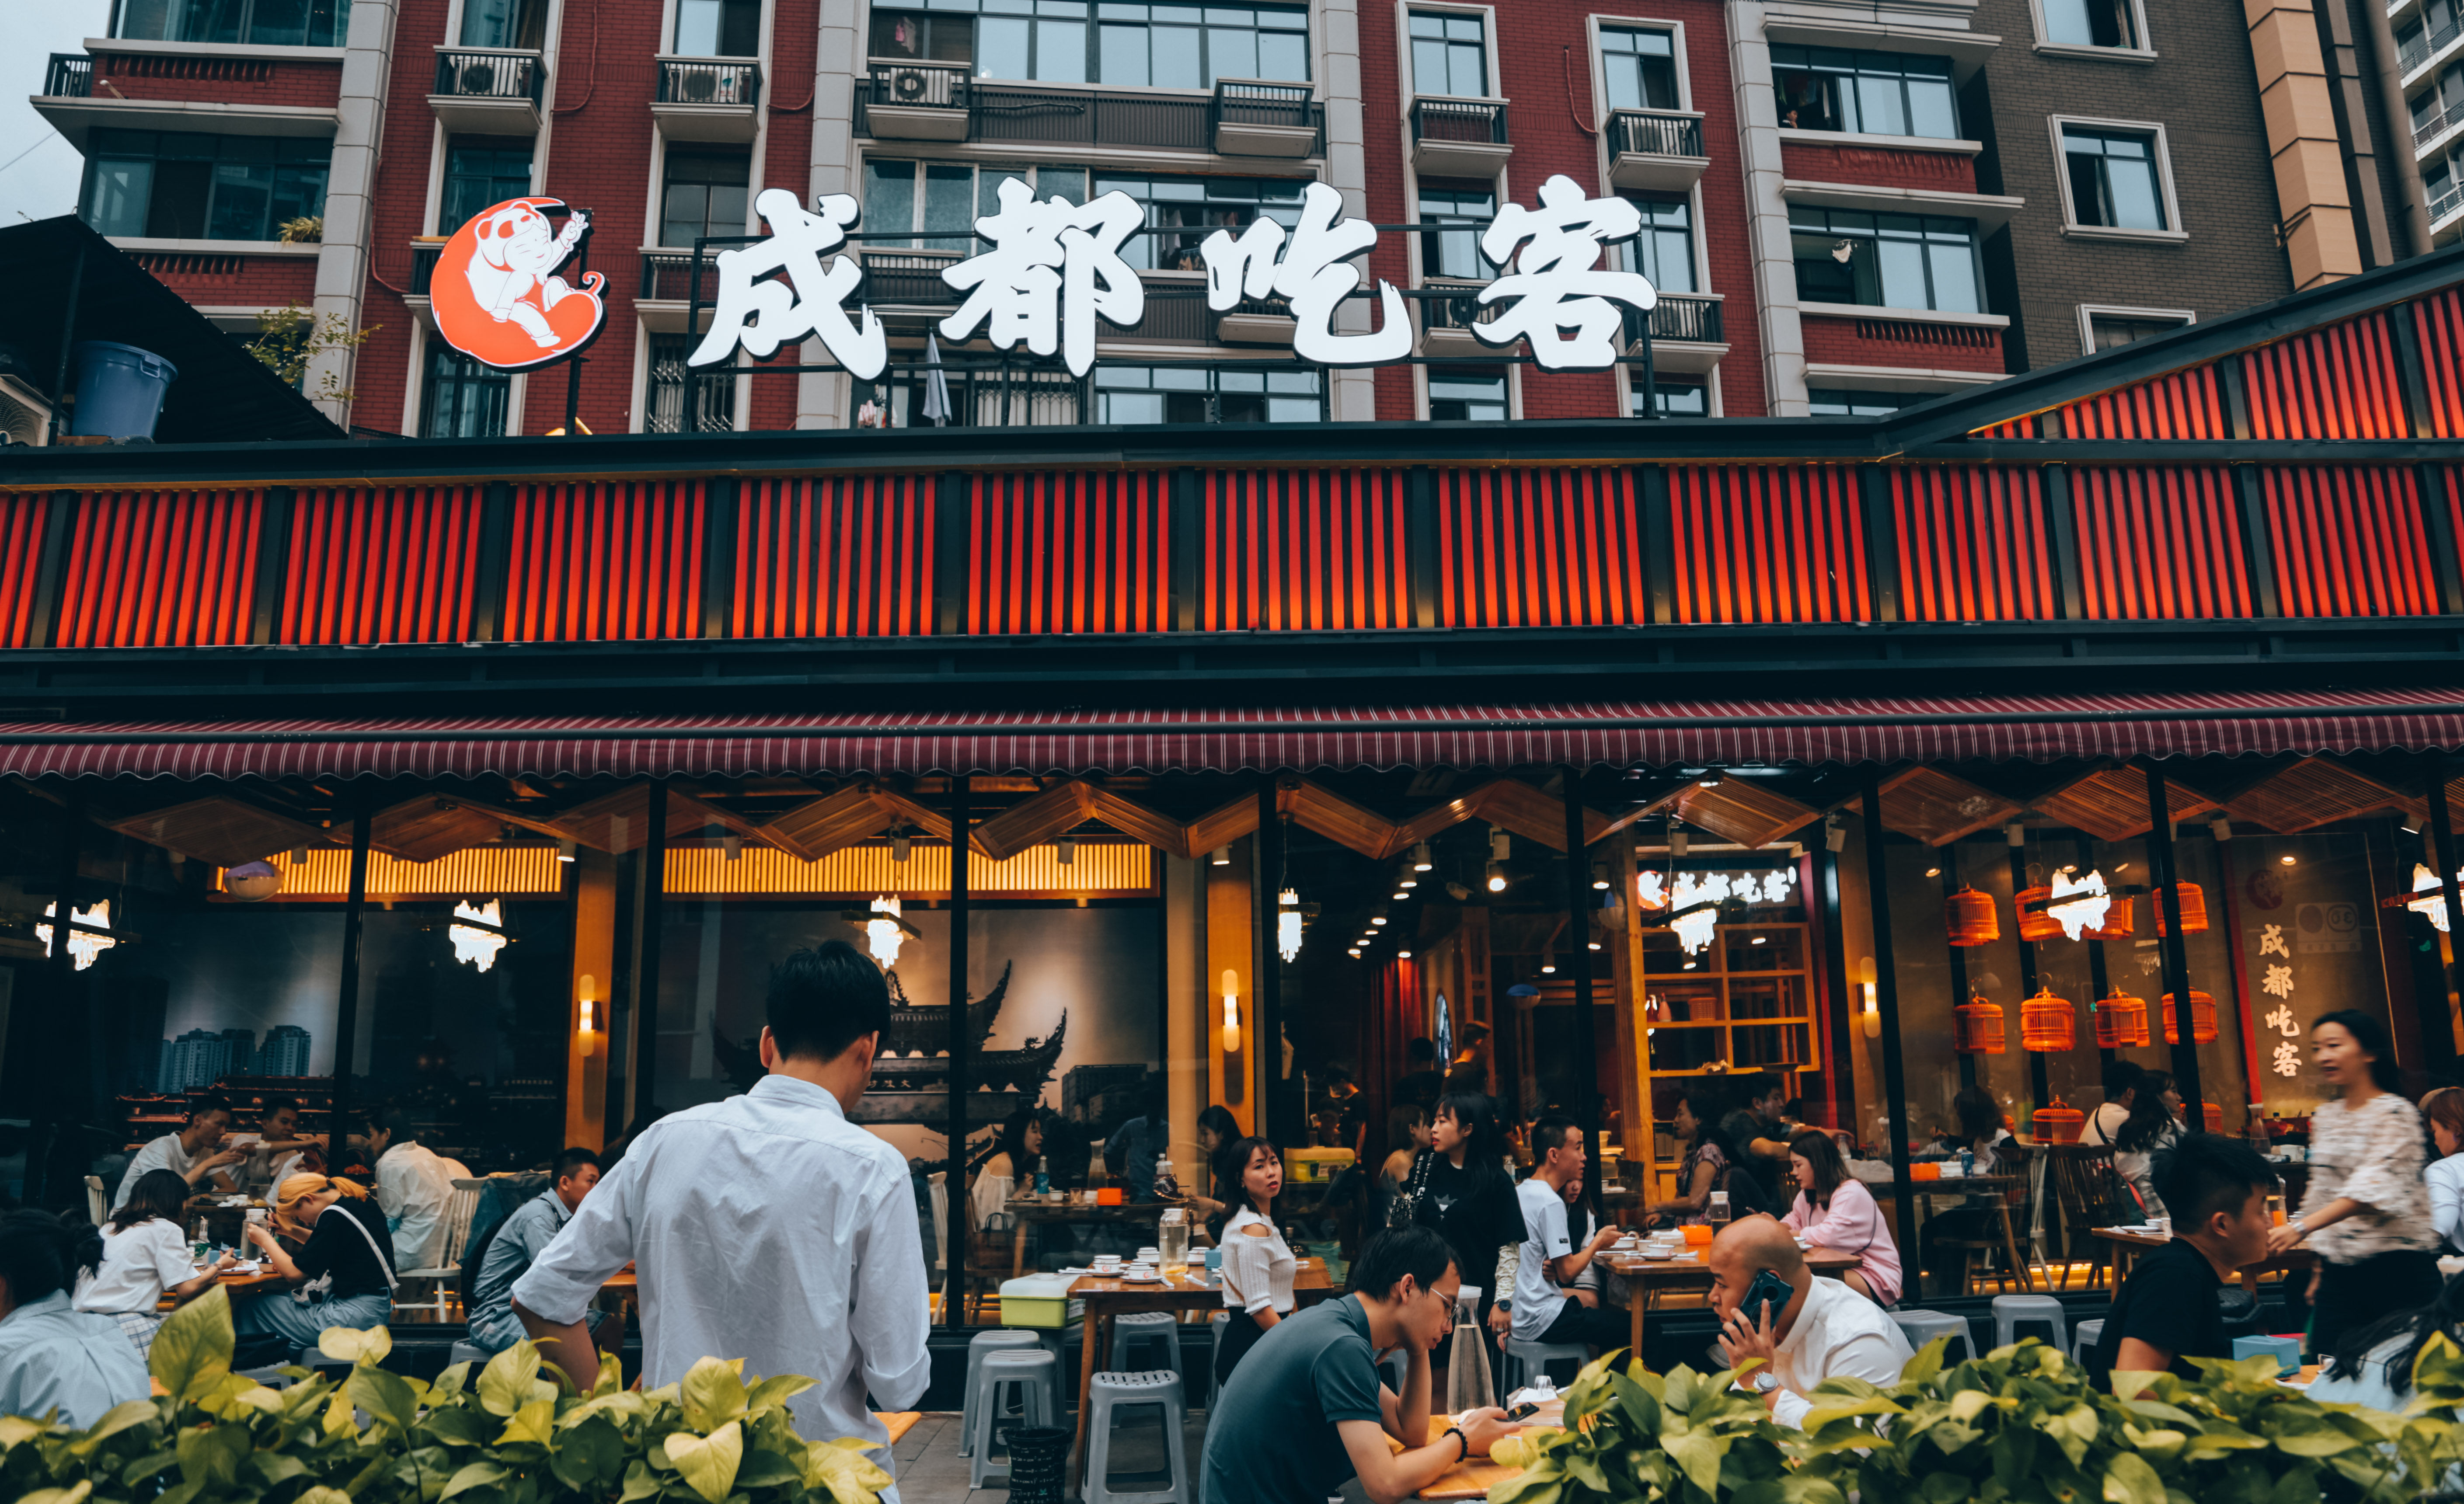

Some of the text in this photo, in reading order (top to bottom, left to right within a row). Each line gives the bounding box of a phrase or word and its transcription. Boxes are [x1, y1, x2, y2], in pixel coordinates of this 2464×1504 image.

[687, 174, 1657, 380] 成都吃客
[2259, 923, 2302, 1077] 成都吃客
